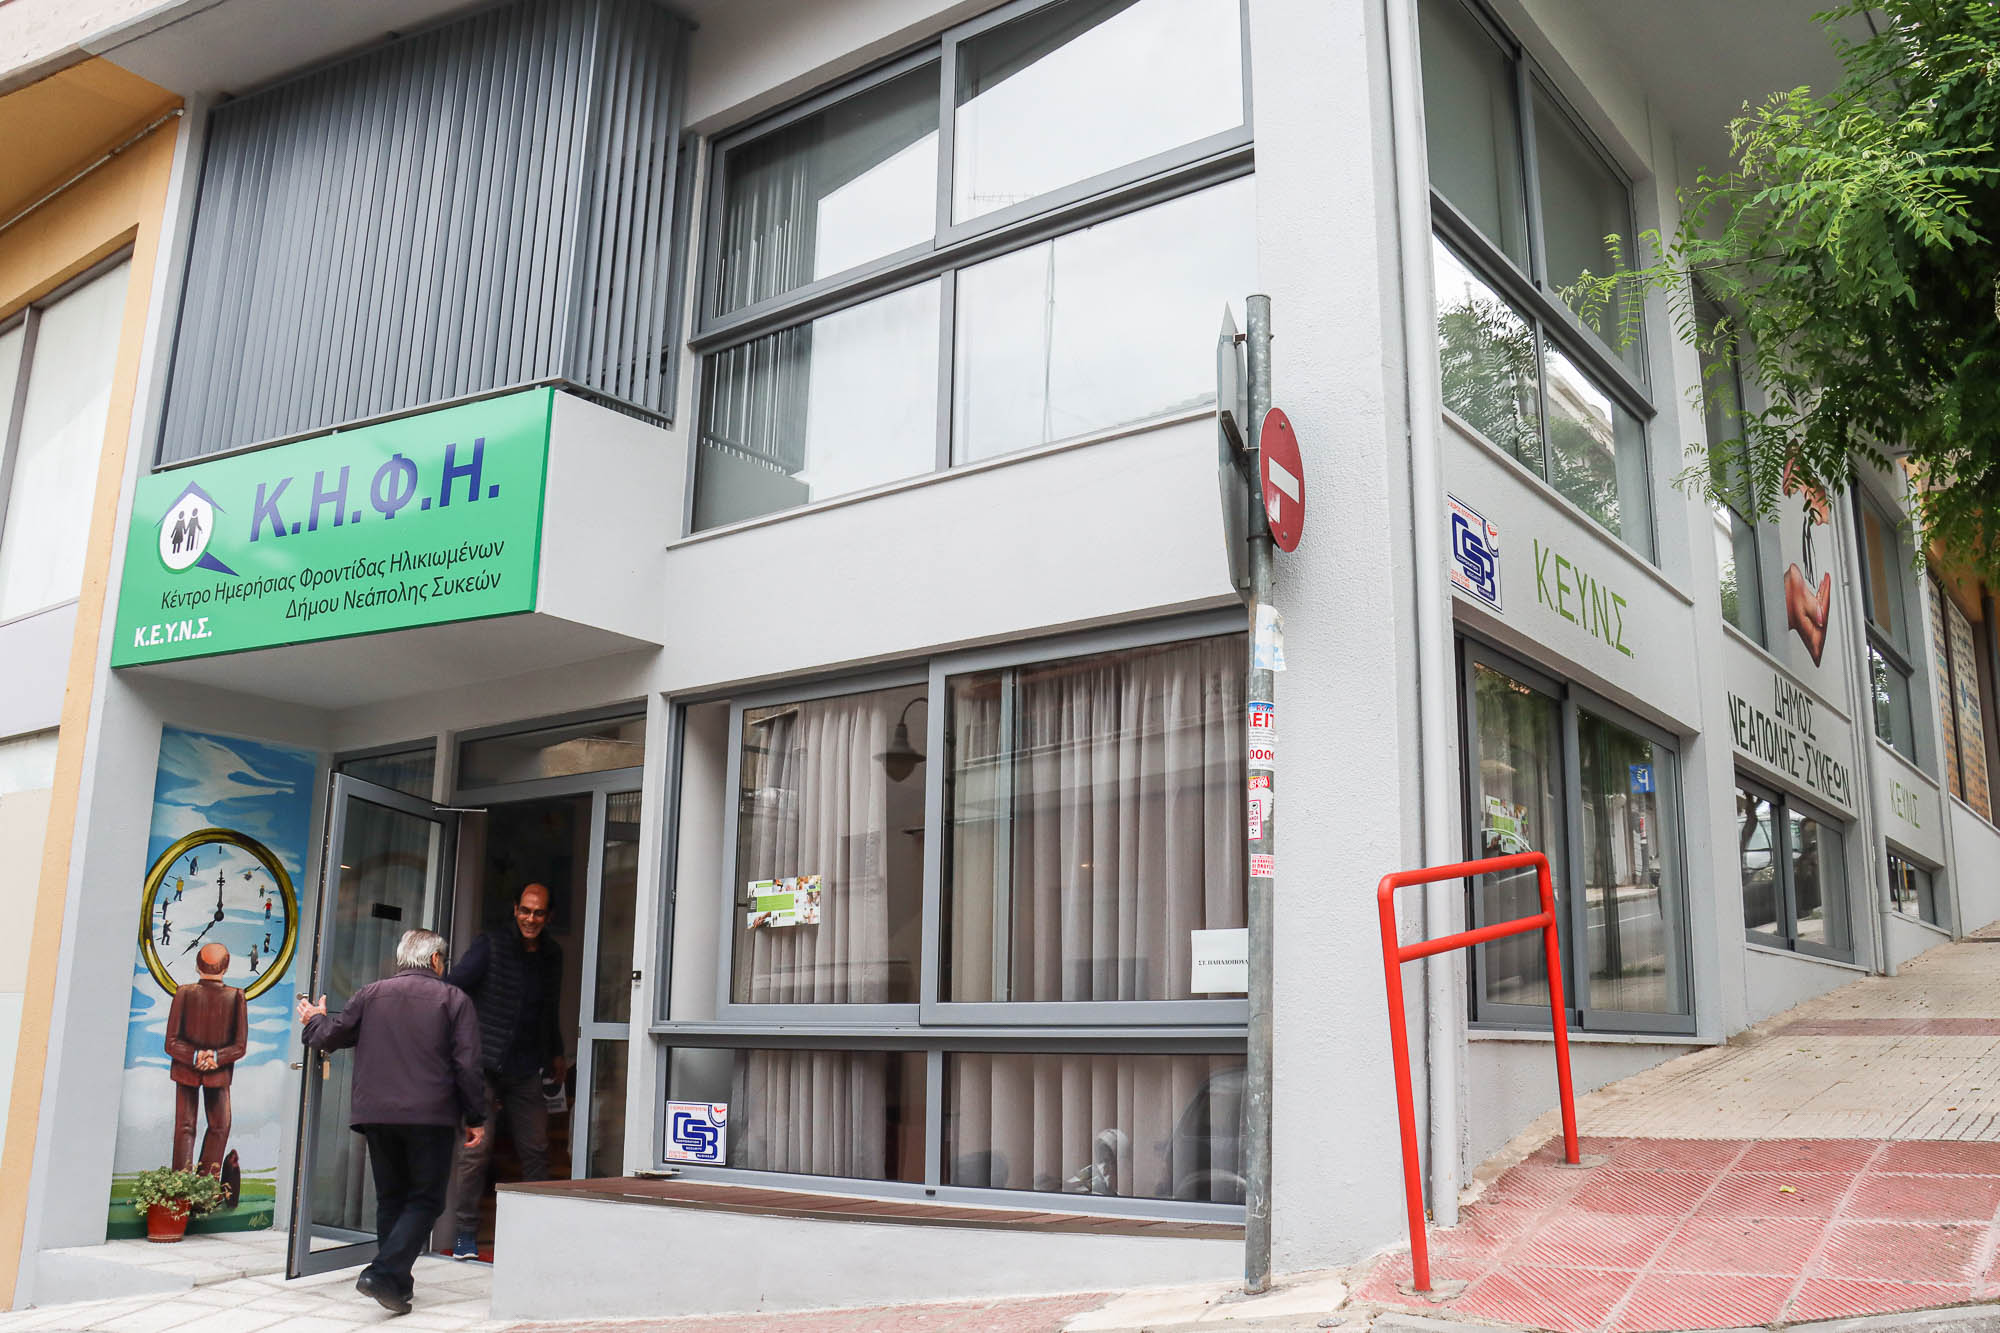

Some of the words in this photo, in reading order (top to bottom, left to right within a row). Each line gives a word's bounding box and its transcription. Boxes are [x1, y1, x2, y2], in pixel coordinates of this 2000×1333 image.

[249, 437, 500, 542] Κ.Η.Φ.Η.
[161, 588, 211, 610] Κέντρο
[215, 574, 296, 604] Ημερήσιας
[300, 557, 386, 590] Φροντίδας
[389, 540, 505, 573] Ηλικιωμένων
[285, 597, 339, 622] Δήμου
[343, 581, 428, 610] Νεάπολης
[431, 569, 502, 598] Συκεών
[134, 617, 213, 648] Κ.Ε.Υ.Ν.Σ.
[1774, 673, 1816, 742] ΔΗΜΟΣ
